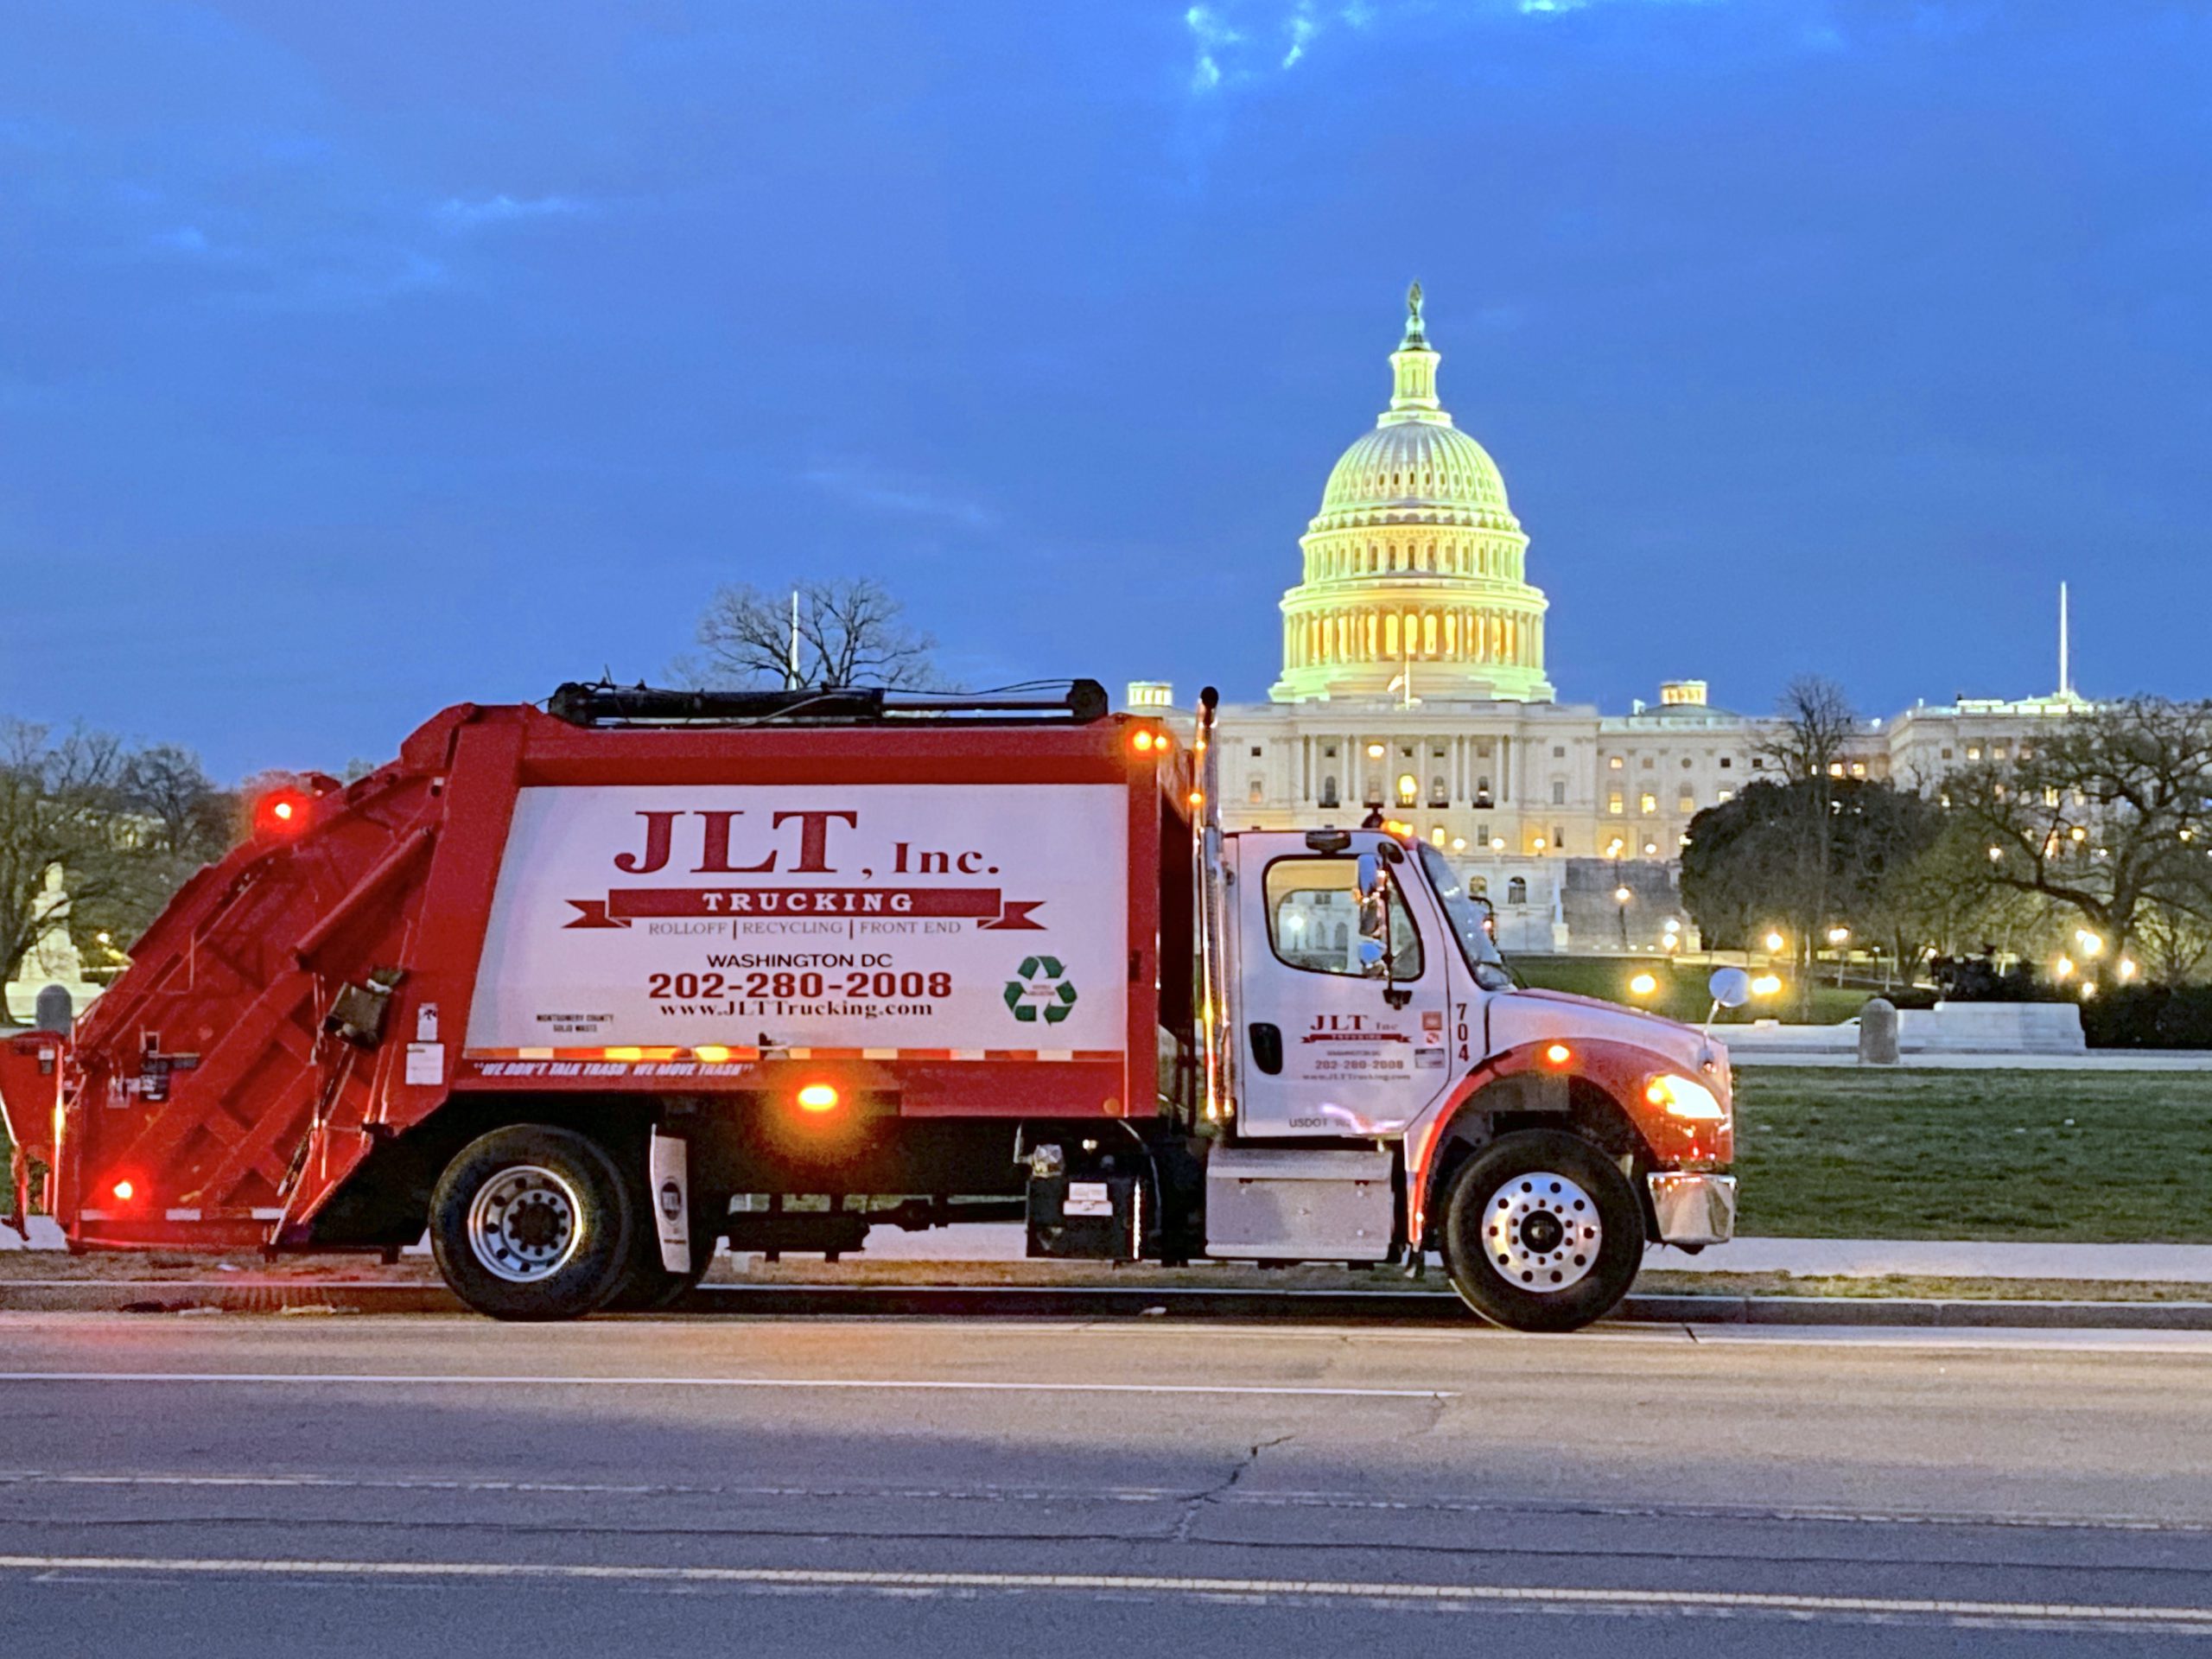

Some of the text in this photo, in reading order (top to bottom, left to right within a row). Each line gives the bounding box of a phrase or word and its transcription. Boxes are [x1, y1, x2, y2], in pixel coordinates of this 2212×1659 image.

[613, 810, 1001, 880] JLT, Inc.
[702, 893, 913, 913] TRUCKING
[648, 920, 962, 935] ROLLOFF RECYCLING FRONT END
[706, 953, 893, 969] WASHINGTON DC
[648, 971, 952, 999] 202-280-2008
[659, 999, 933, 1019] www.JLTTrucking.com
[549, 1062, 583, 1077] TALK
[583, 1062, 629, 1077] TRASH
[632, 1063, 656, 1077] WE
[655, 1063, 698, 1077] MOVE
[1314, 1059, 1405, 1070] 202-280-2008
[1288, 1118, 1328, 1128] USDOT
